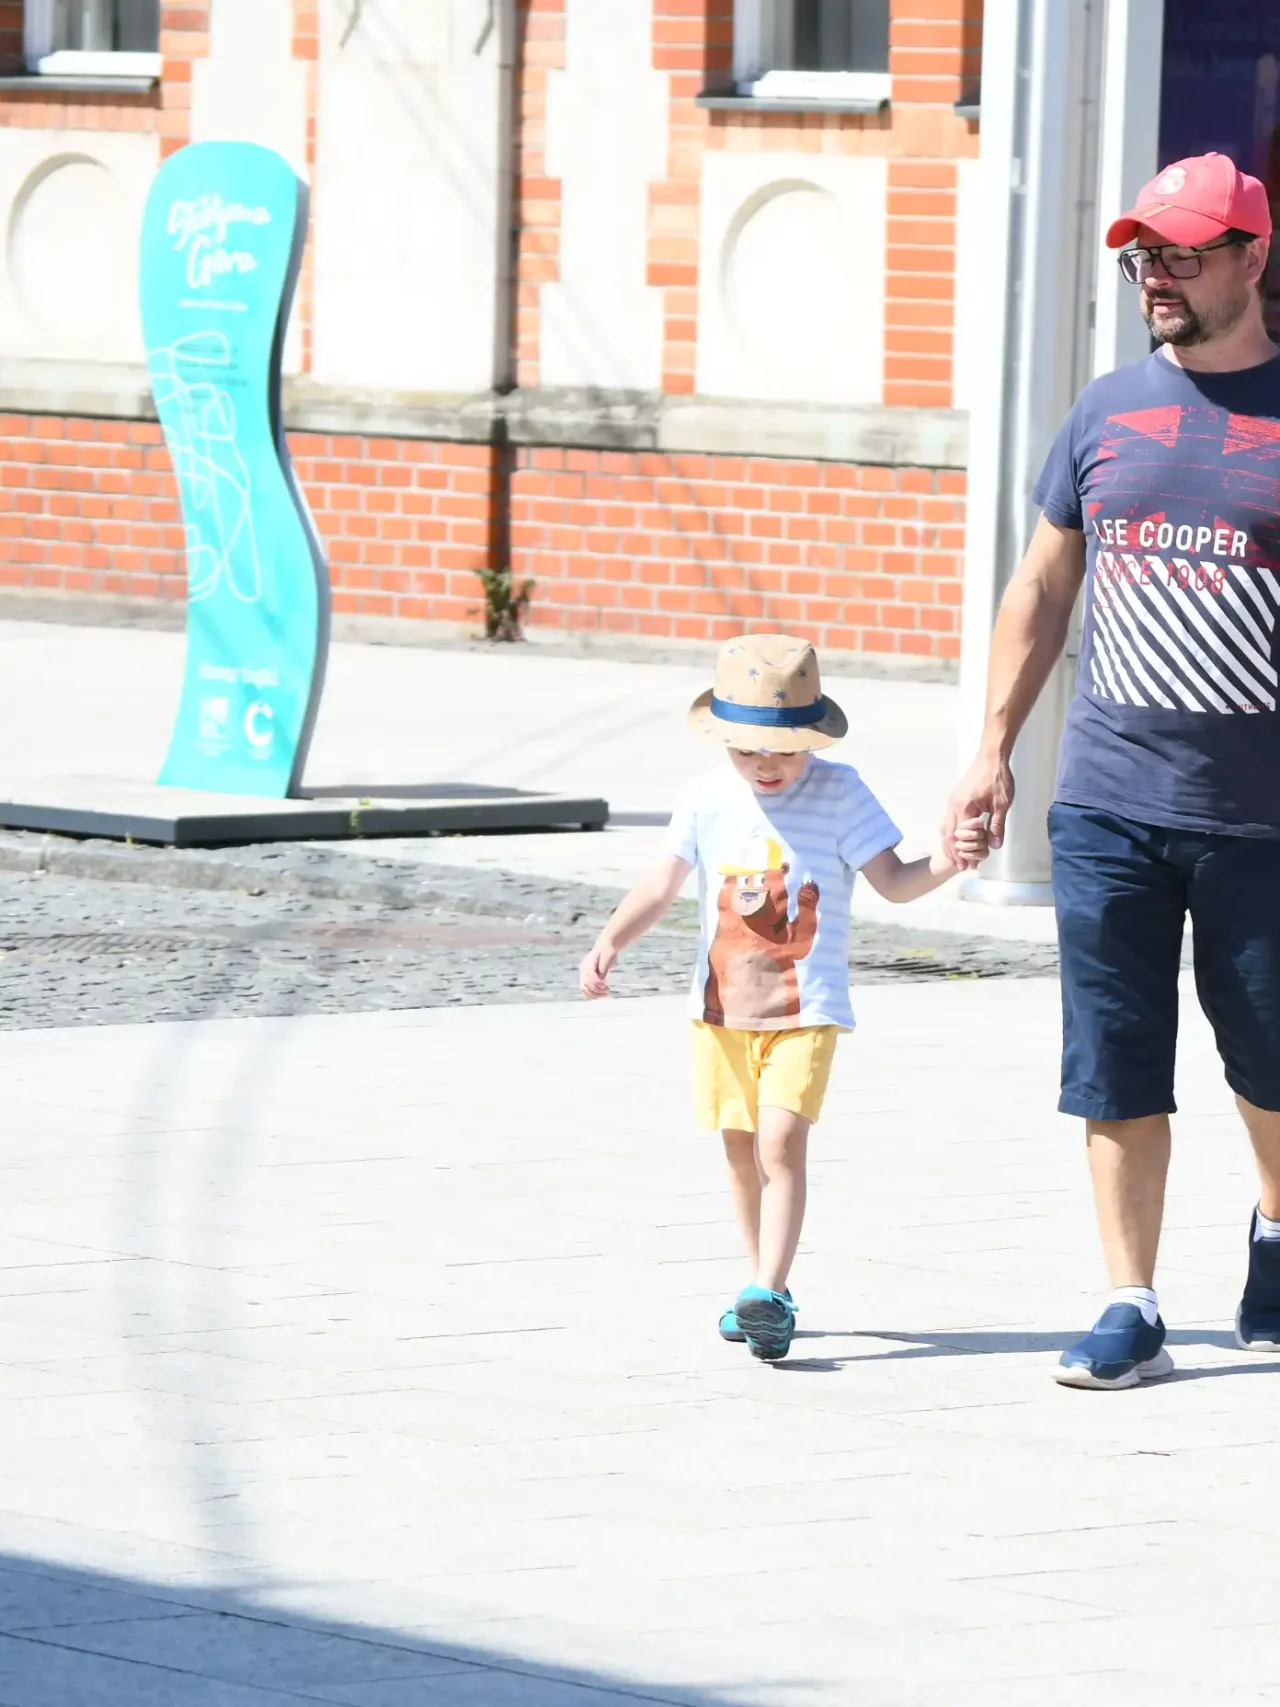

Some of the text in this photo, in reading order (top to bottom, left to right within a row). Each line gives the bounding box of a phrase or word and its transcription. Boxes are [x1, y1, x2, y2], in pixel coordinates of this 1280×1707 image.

[1092, 519, 1248, 557] LEE COOPER
[1167, 561, 1226, 593] 1908
